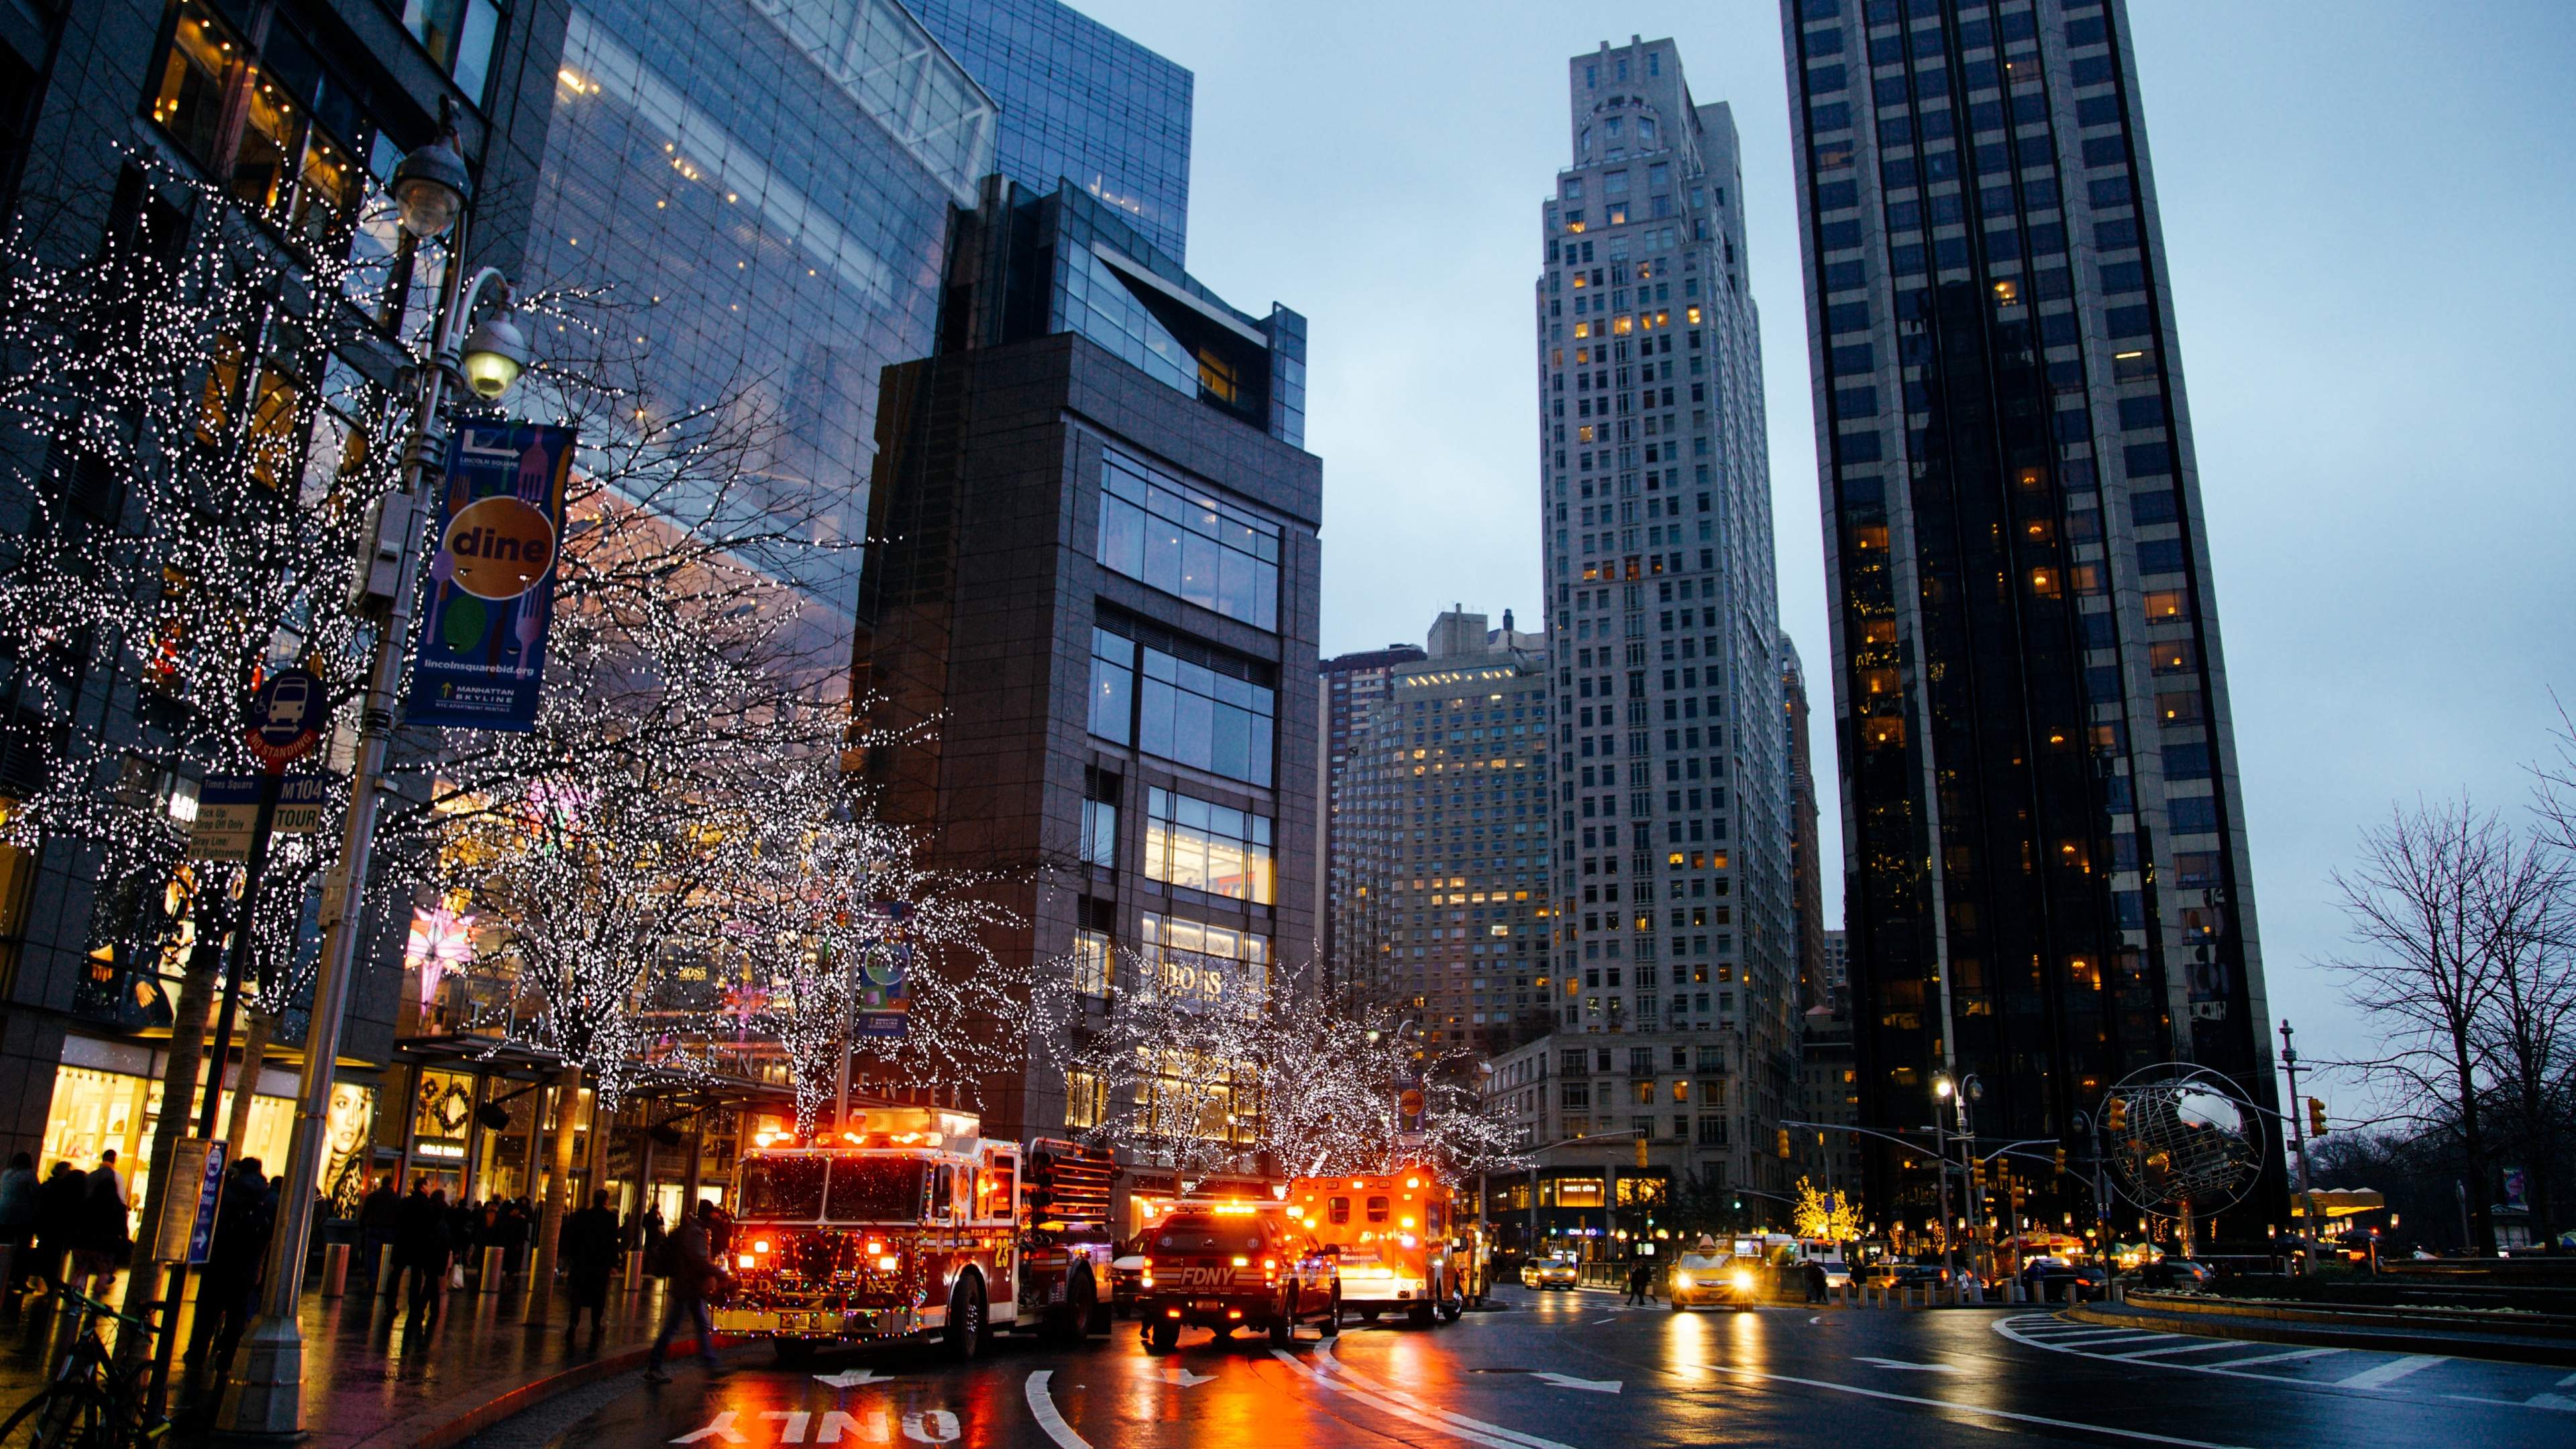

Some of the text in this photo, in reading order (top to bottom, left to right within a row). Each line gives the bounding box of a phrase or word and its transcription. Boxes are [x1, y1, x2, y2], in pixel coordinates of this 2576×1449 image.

[460, 457, 490, 465] LINCOLN
[490, 460, 519, 468] SQUARE
[453, 527, 546, 562] dine
[425, 659, 535, 676] lincolnsquarebid.org
[457, 686, 515, 696] MANHATTAN
[455, 694, 513, 704] SKYLINE
[250, 733, 312, 759] NO STANDING
[204, 779, 254, 791] Times Square
[280, 780, 323, 800] M104
[199, 807, 215, 818] Pick
[277, 809, 318, 827] TOUR
[196, 819, 244, 830] Drop Off Only
[192, 836, 209, 847] Gray
[190, 848, 245, 859] NY Sightseeing
[203, 1179, 216, 1192] Bus
[201, 1193, 215, 1207] Stop
[996, 1229, 1009, 1237] ENGINE
[996, 1238, 1009, 1267] 23
[1180, 1267, 1237, 1285] FDNY
[668, 1410, 961, 1444] ONLY
